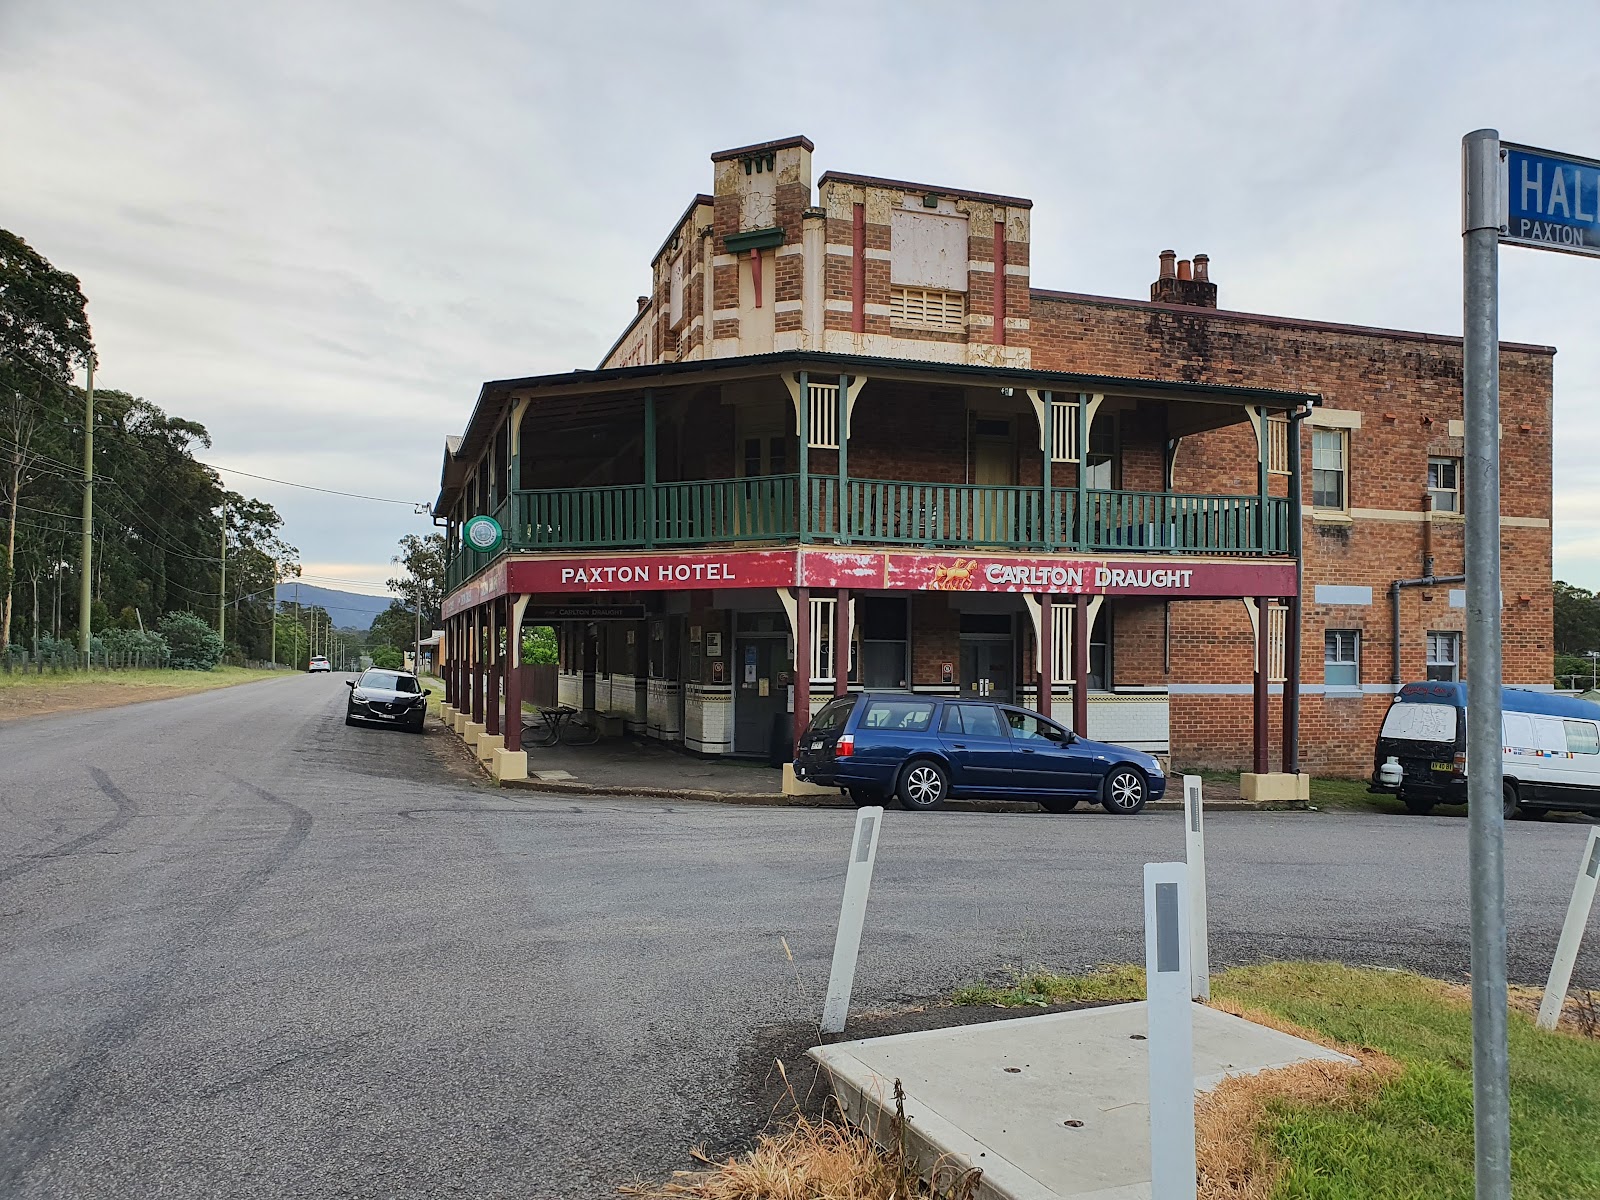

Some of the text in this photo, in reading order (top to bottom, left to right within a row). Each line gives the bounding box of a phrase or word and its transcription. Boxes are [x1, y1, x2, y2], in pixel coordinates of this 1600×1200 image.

[1521, 160, 1600, 223] HAL
[1521, 219, 1583, 246] PAXTON
[561, 563, 736, 584] PAXTON HOTEL
[985, 564, 1193, 588] CARLTON DRAUGHT
